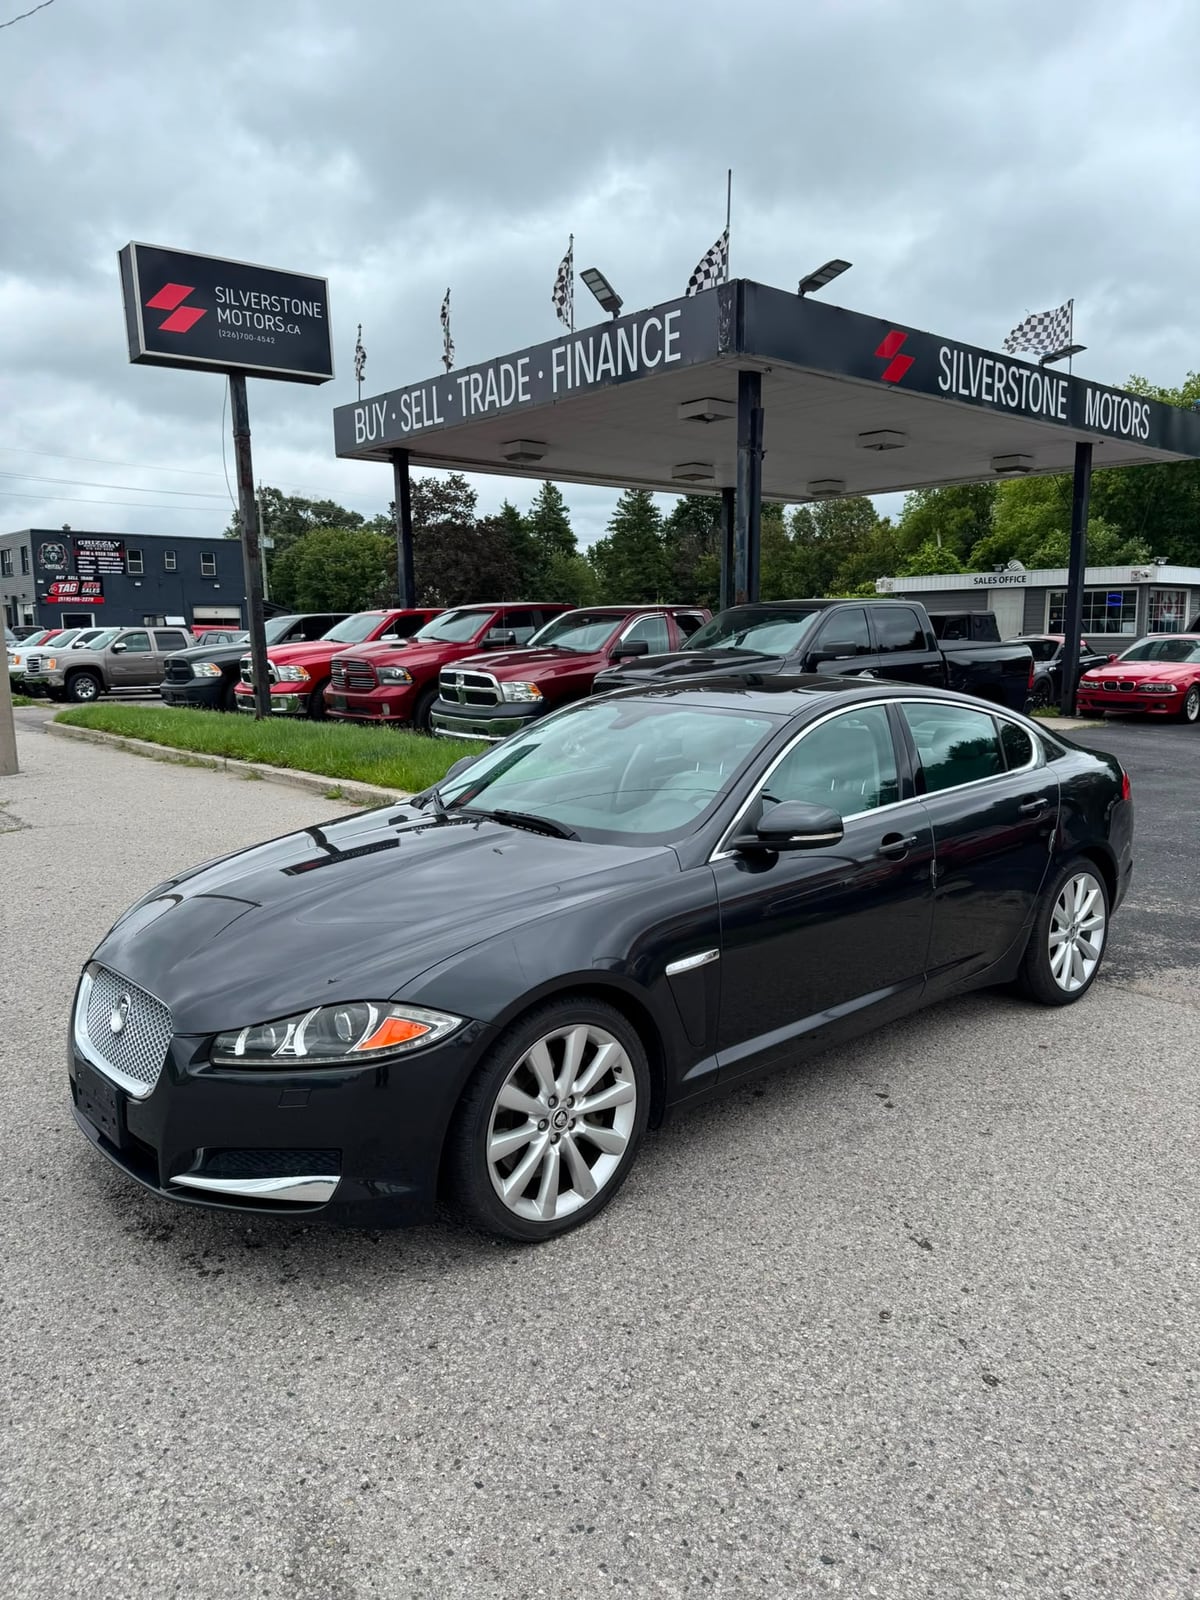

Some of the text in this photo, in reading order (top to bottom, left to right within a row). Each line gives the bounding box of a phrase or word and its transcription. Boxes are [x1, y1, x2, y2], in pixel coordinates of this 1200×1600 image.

[215, 286, 322, 318] SILVERSTONE
[219, 329, 276, 344] (226)700-4542
[354, 309, 682, 444] BUY SELL TRADE FINANCE
[938, 346, 1151, 440] SILVERSTONE MOTORS
[58, 583, 77, 593] TAG
[973, 575, 1027, 585] SALES OFFICE
